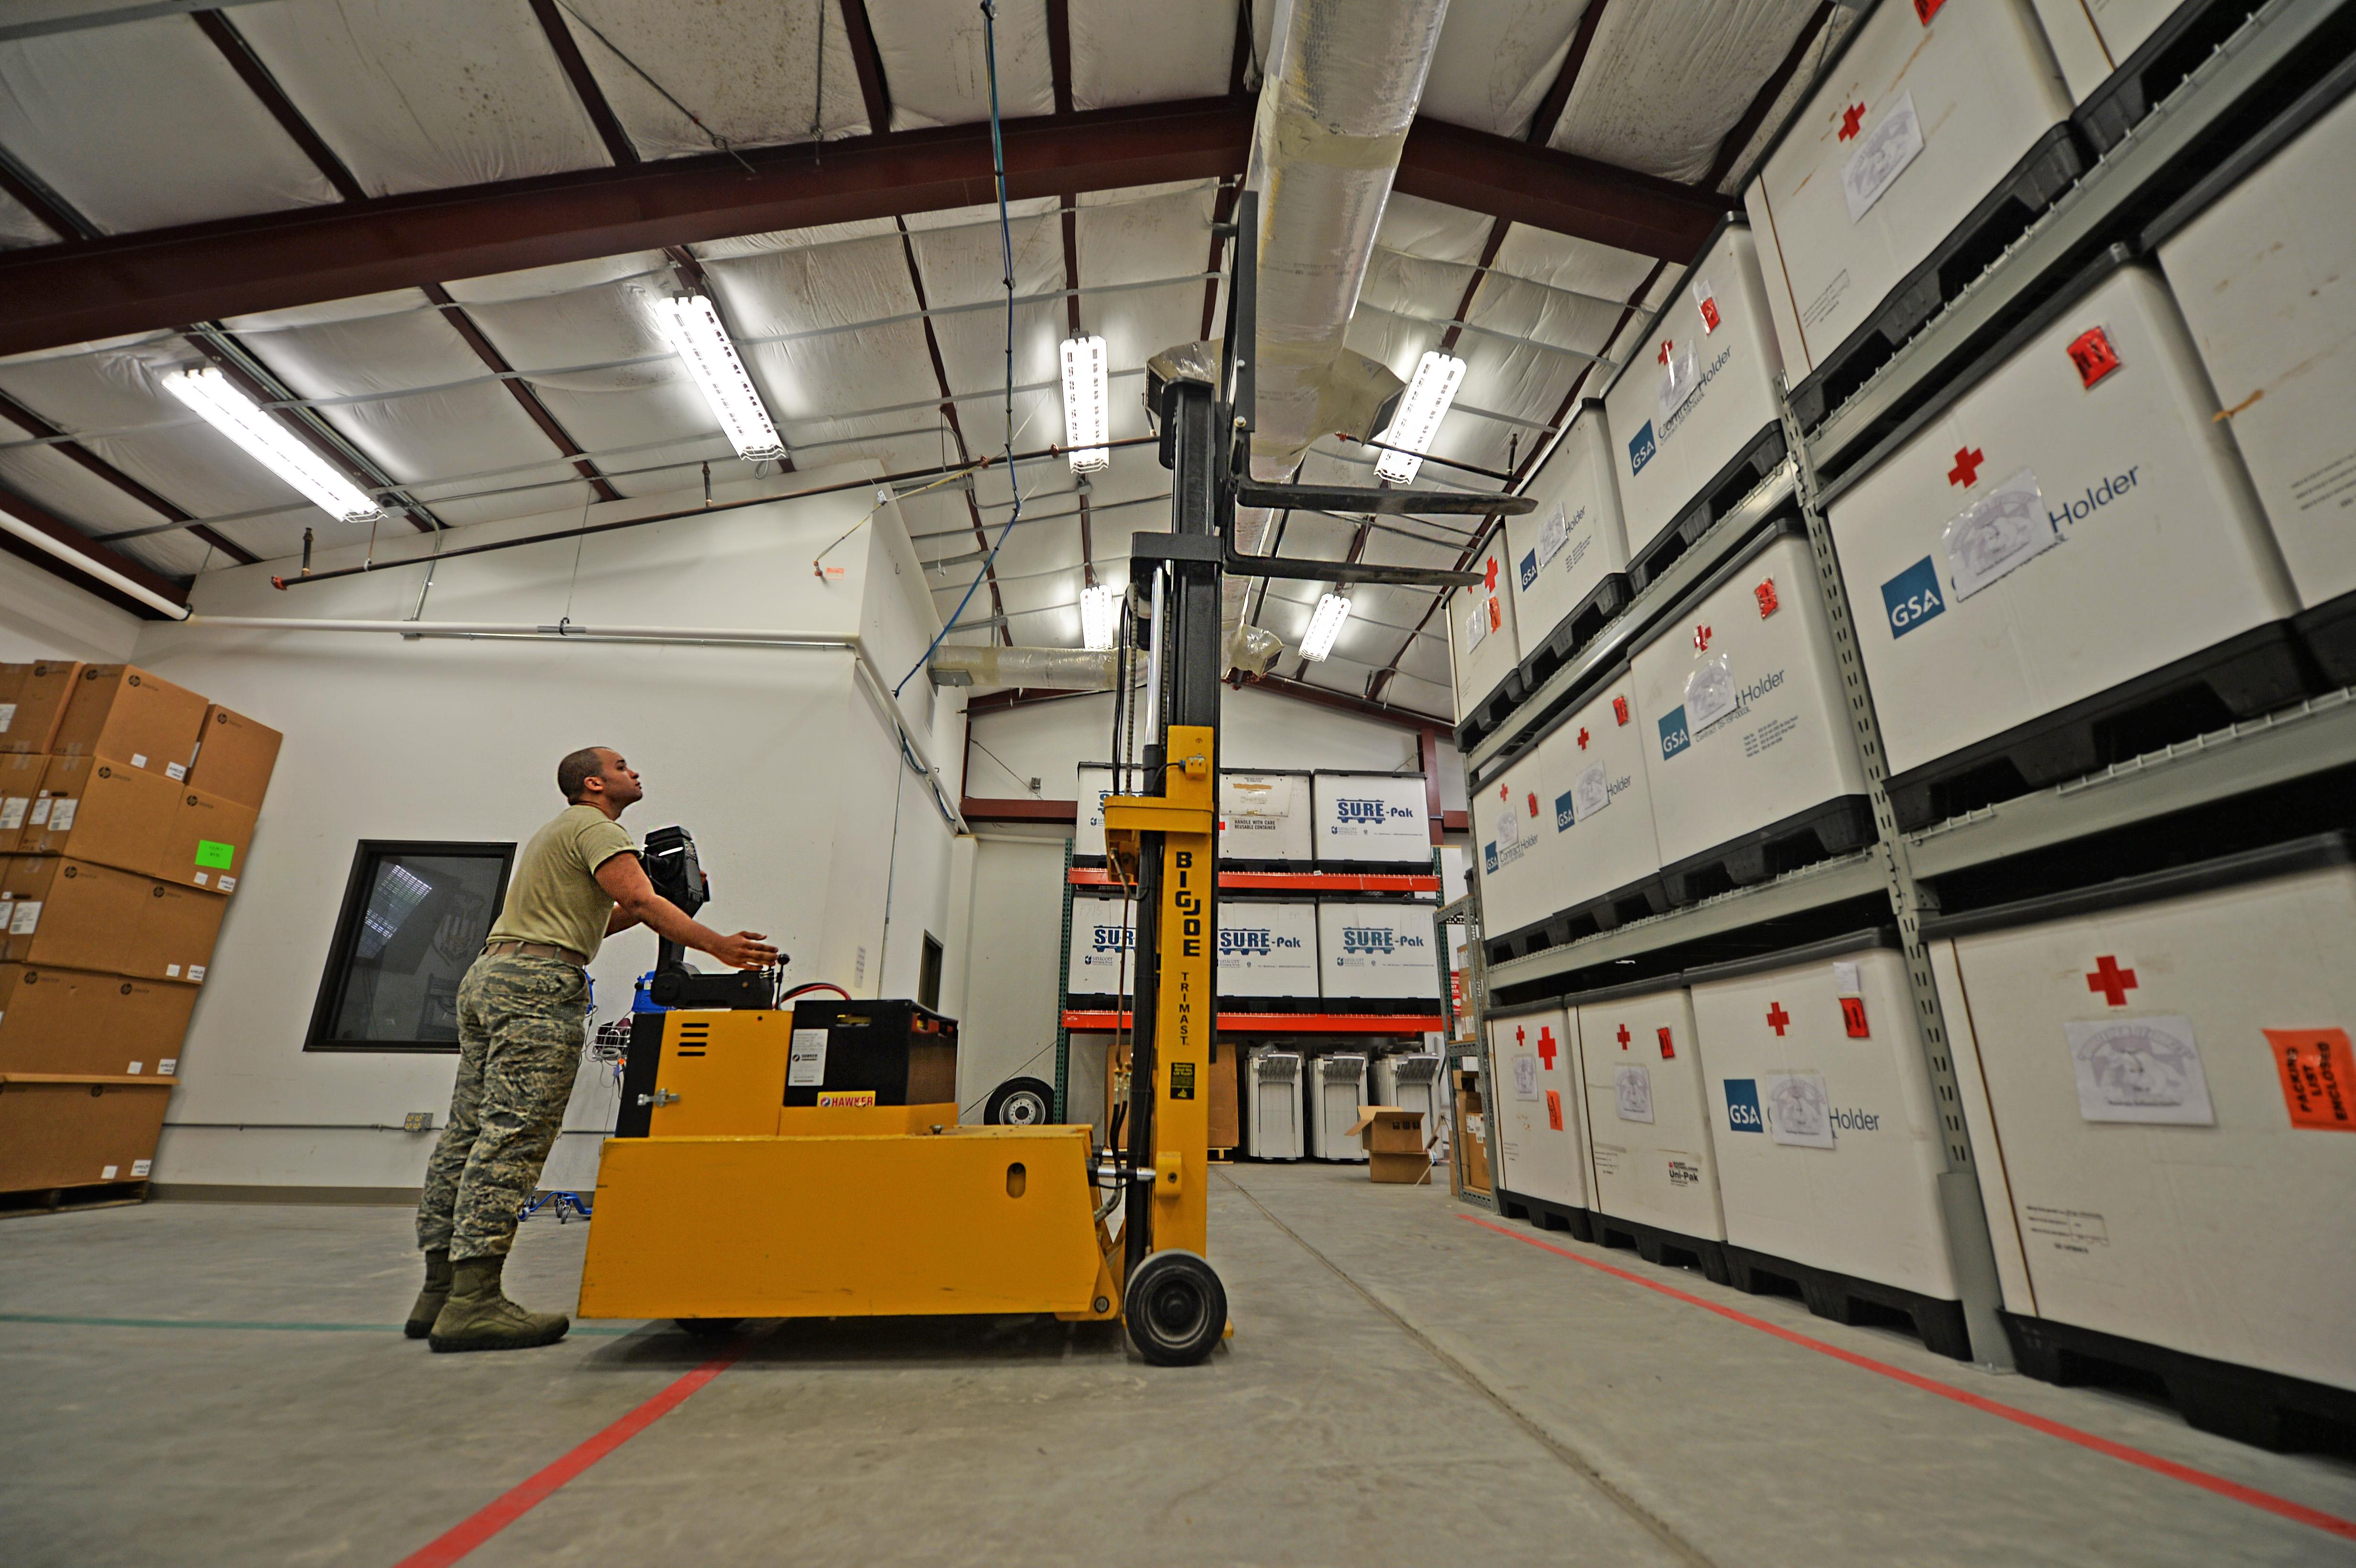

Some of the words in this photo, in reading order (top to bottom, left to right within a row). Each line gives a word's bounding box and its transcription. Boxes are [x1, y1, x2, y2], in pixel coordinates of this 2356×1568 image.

[1632, 440, 1655, 468] GSA
[1697, 346, 1732, 392] Holder
[2049, 466, 2139, 534] Holder
[1566, 506, 1586, 535] Holder
[1522, 566, 1537, 586] GSA
[1891, 588, 1941, 627] GSA
[1742, 670, 1785, 705] Holder
[1663, 729, 1688, 752] GSA
[1607, 775, 1632, 796] Holder
[1558, 809, 1573, 827] GSA
[1487, 856, 1498, 871] GSA
[1176, 851, 1192, 908] BIG
[1183, 899, 1200, 956] JOE
[1178, 972, 1190, 1045] TRIMAST
[2287, 1047, 2312, 1113] PACKING
[2301, 1065, 2322, 1097] LIST
[2317, 1041, 2348, 1121] ENCLOSED
[832, 1096, 873, 1107] HAWKER
[1730, 1105, 1761, 1125] GSA
[1829, 1108, 1880, 1131] Holder
[1669, 1169, 1699, 1182] Uni-Pak
